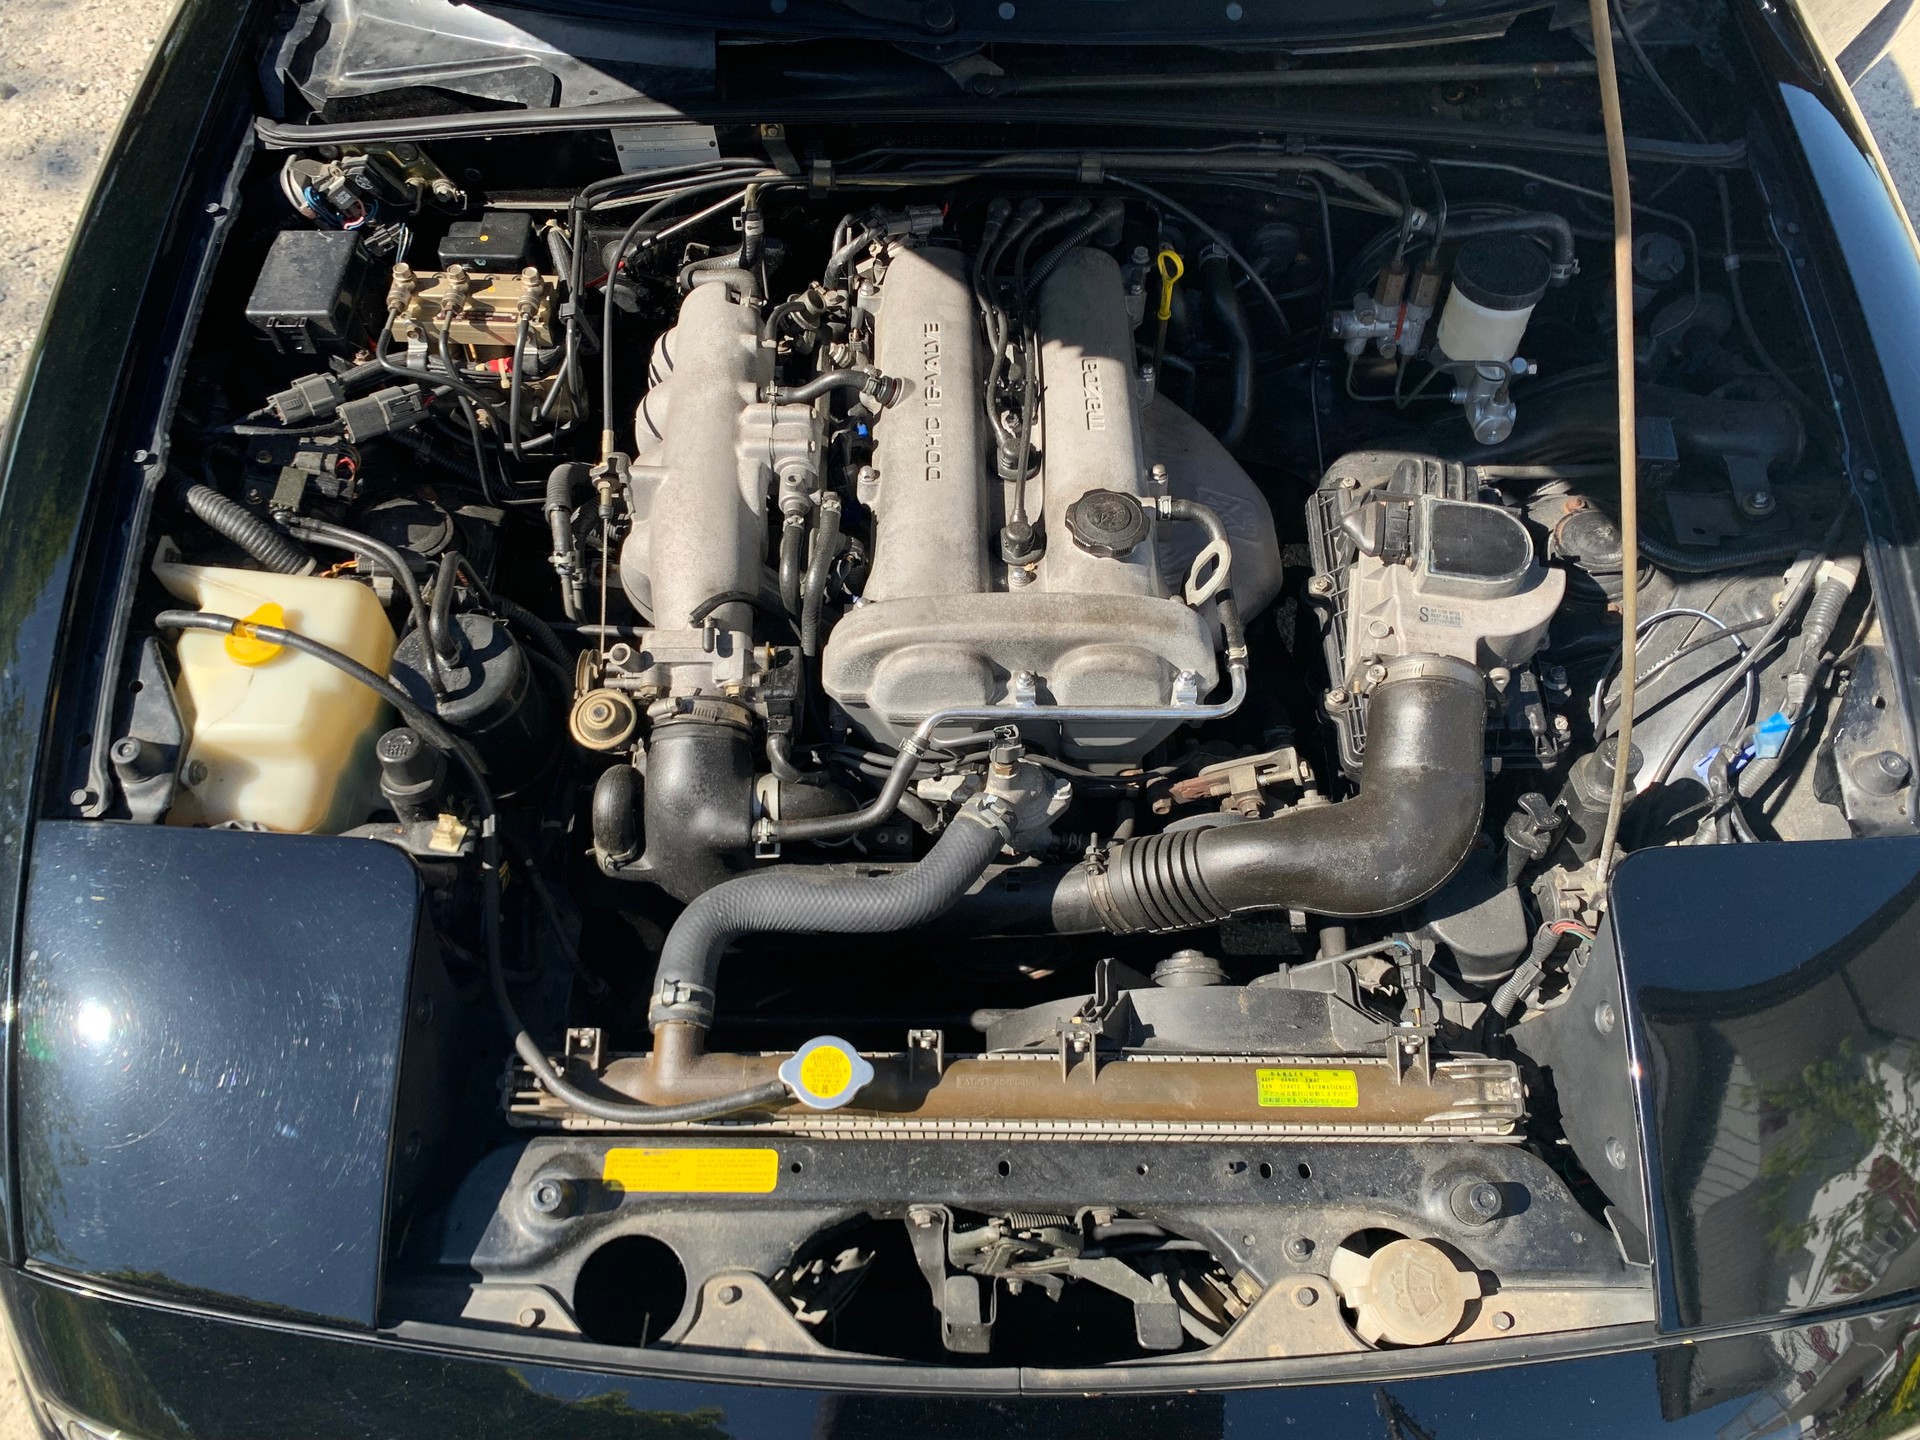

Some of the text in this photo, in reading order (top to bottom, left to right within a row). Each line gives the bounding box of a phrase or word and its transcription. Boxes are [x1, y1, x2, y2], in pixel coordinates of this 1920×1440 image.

[924, 322, 942, 482] DOHC 16-VALVE
[1419, 606, 1429, 623] S
